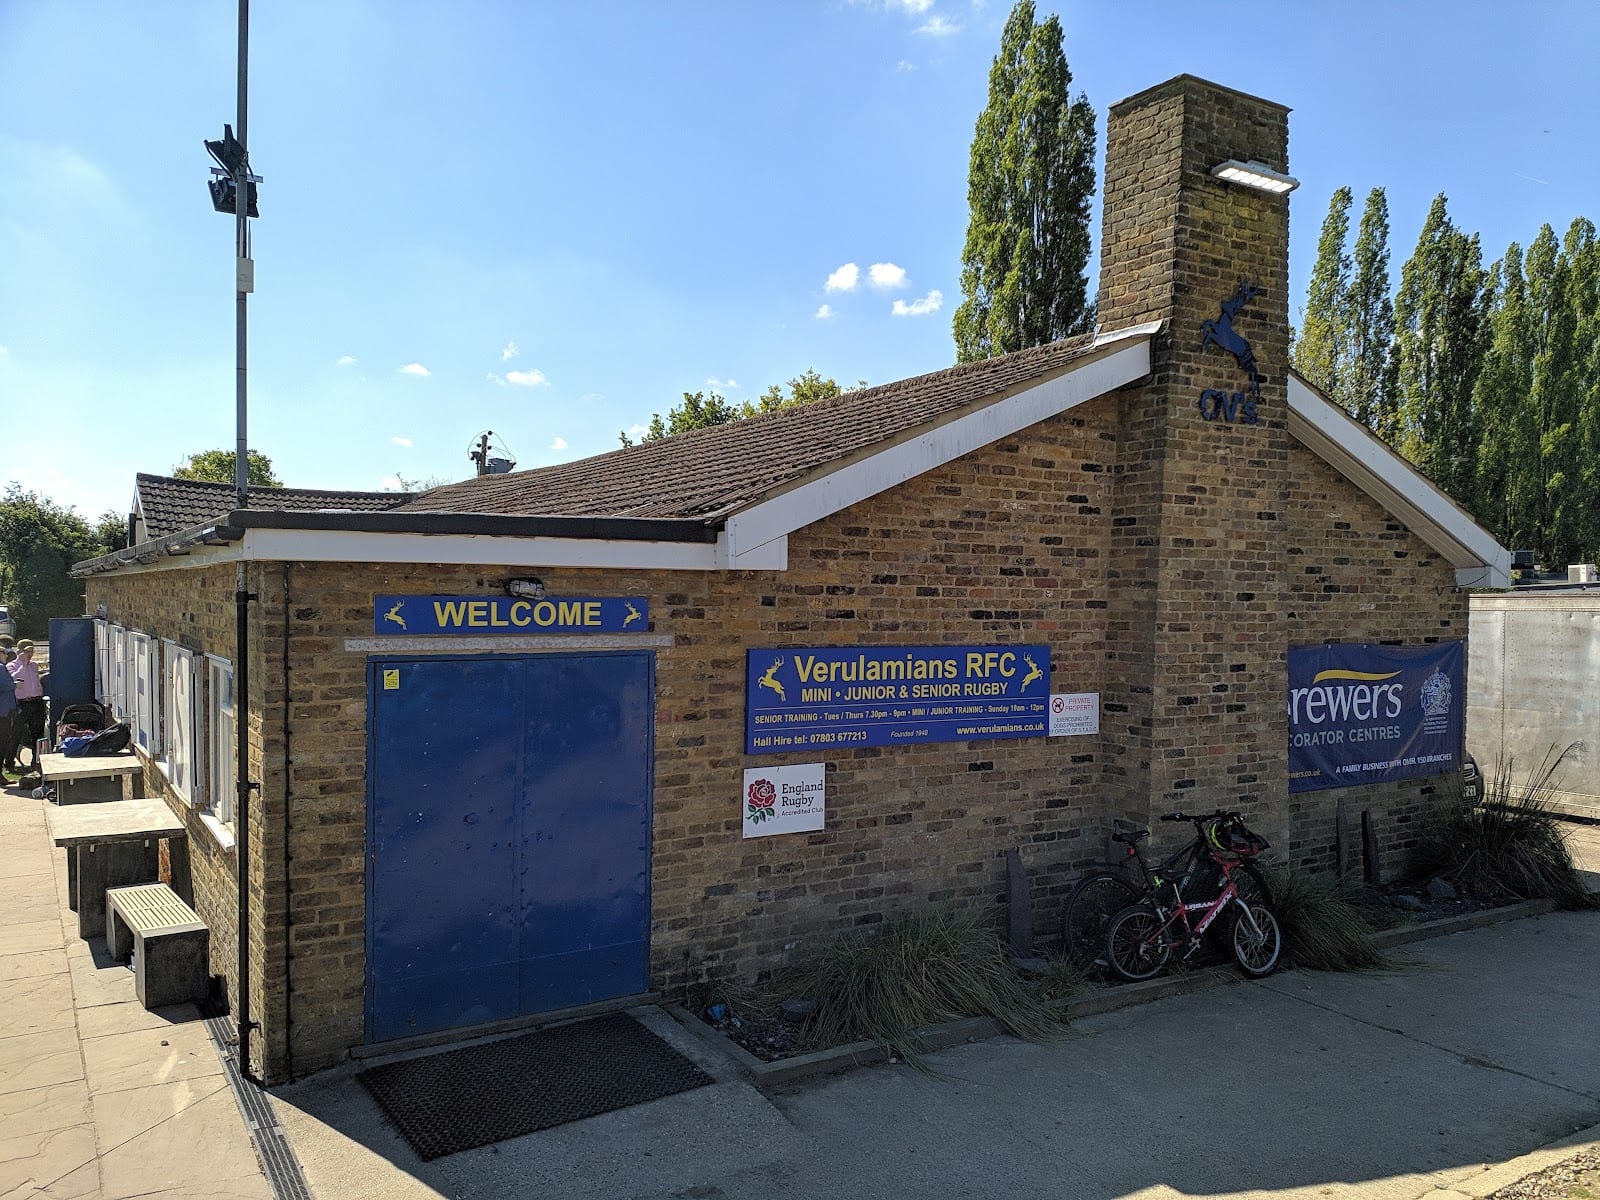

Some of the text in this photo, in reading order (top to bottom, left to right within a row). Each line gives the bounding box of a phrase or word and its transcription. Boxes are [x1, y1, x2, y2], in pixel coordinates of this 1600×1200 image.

[433, 601, 602, 627] WELCOME
[793, 651, 1016, 683] Verulamians RFC
[801, 682, 1008, 702] MINI JUNIOR & SENIOR RUGBY
[1288, 683, 1404, 725] rewers
[754, 714, 783, 724] SENIOR
[784, 712, 818, 723] TRAINING
[824, 711, 840, 720] Tues
[845, 711, 864, 719] Thurs
[865, 710, 888, 720] 7.30pm
[893, 709, 907, 718] 9pm
[912, 707, 926, 716] MINI
[930, 706, 953, 716] JUNIOR
[955, 704, 983, 714] TRAINING
[988, 704, 1009, 713] Sunday
[1030, 703, 1045, 713] 12pm
[890, 730, 914, 738] Founded
[956, 722, 1045, 735] www.verulamians.co.uk
[1348, 725, 1401, 742] CENTRES
[753, 731, 867, 747] Hall Hire tel: 07803 677213
[1341, 764, 1361, 773] FAMILY
[1362, 761, 1389, 771] BUSINESS
[1389, 759, 1402, 768] WITH
[1402, 757, 1417, 766] OVER
[1417, 756, 1427, 764] 150
[1426, 752, 1453, 763] BRANCHES
[782, 780, 823, 795] England
[782, 794, 814, 808] Rugby
[782, 808, 811, 816] Accredited
